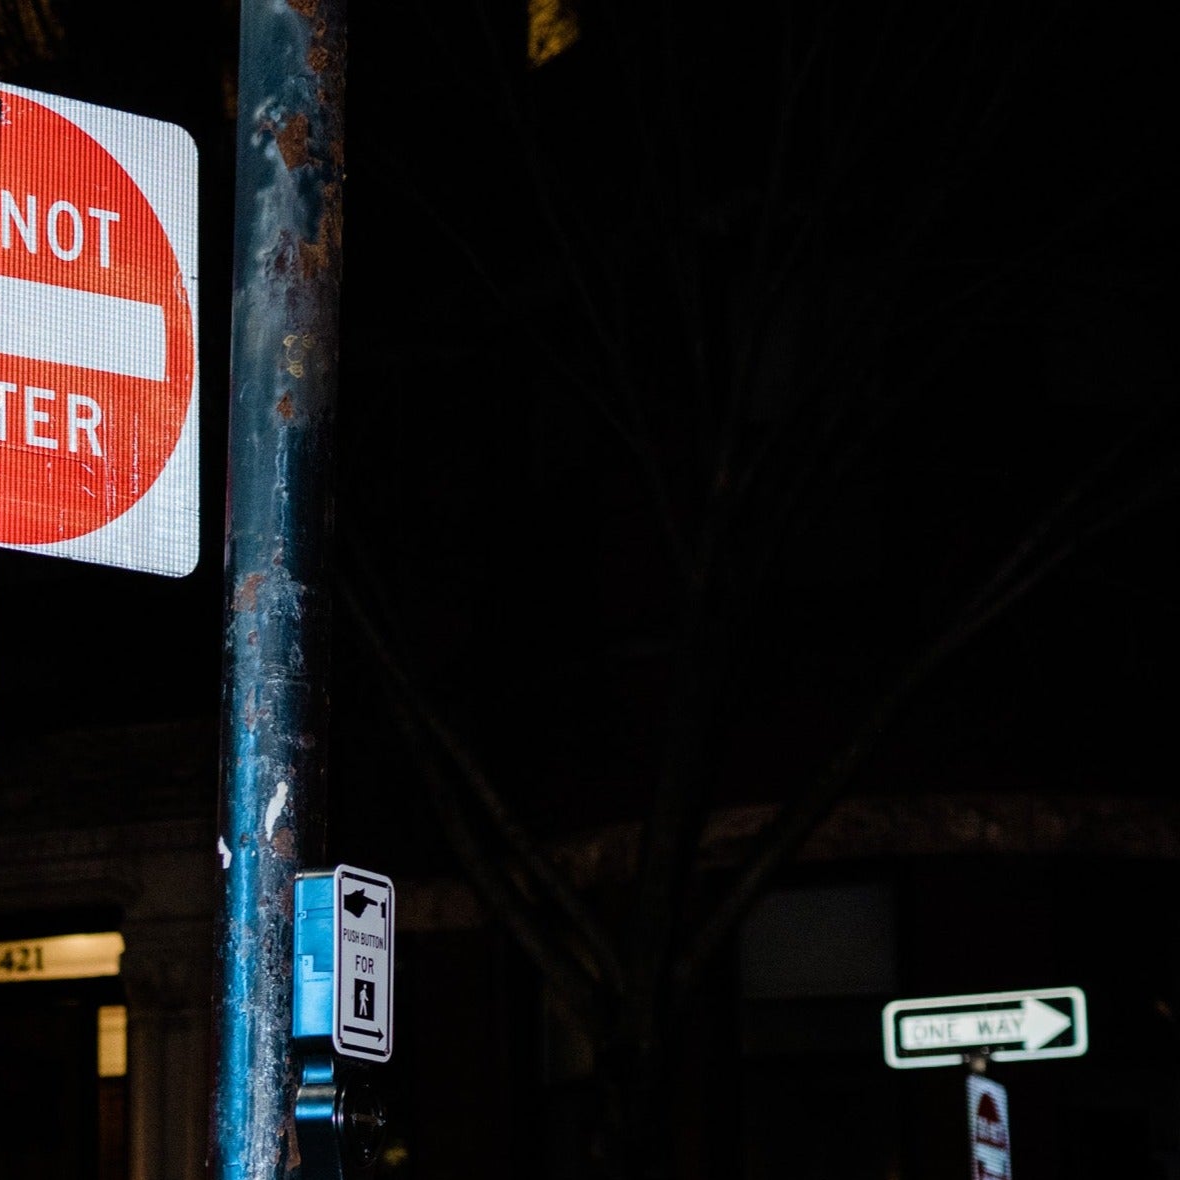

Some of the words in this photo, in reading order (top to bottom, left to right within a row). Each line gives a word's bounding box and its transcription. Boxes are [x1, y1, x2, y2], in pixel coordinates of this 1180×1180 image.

[0, 190, 120, 268] NOT
[343, 928, 360, 943] PUSH
[361, 932, 384, 950] BUTTON
[355, 955, 375, 975] FOR
[912, 1019, 959, 1042] ONE
[977, 1016, 1023, 1037] WAY
